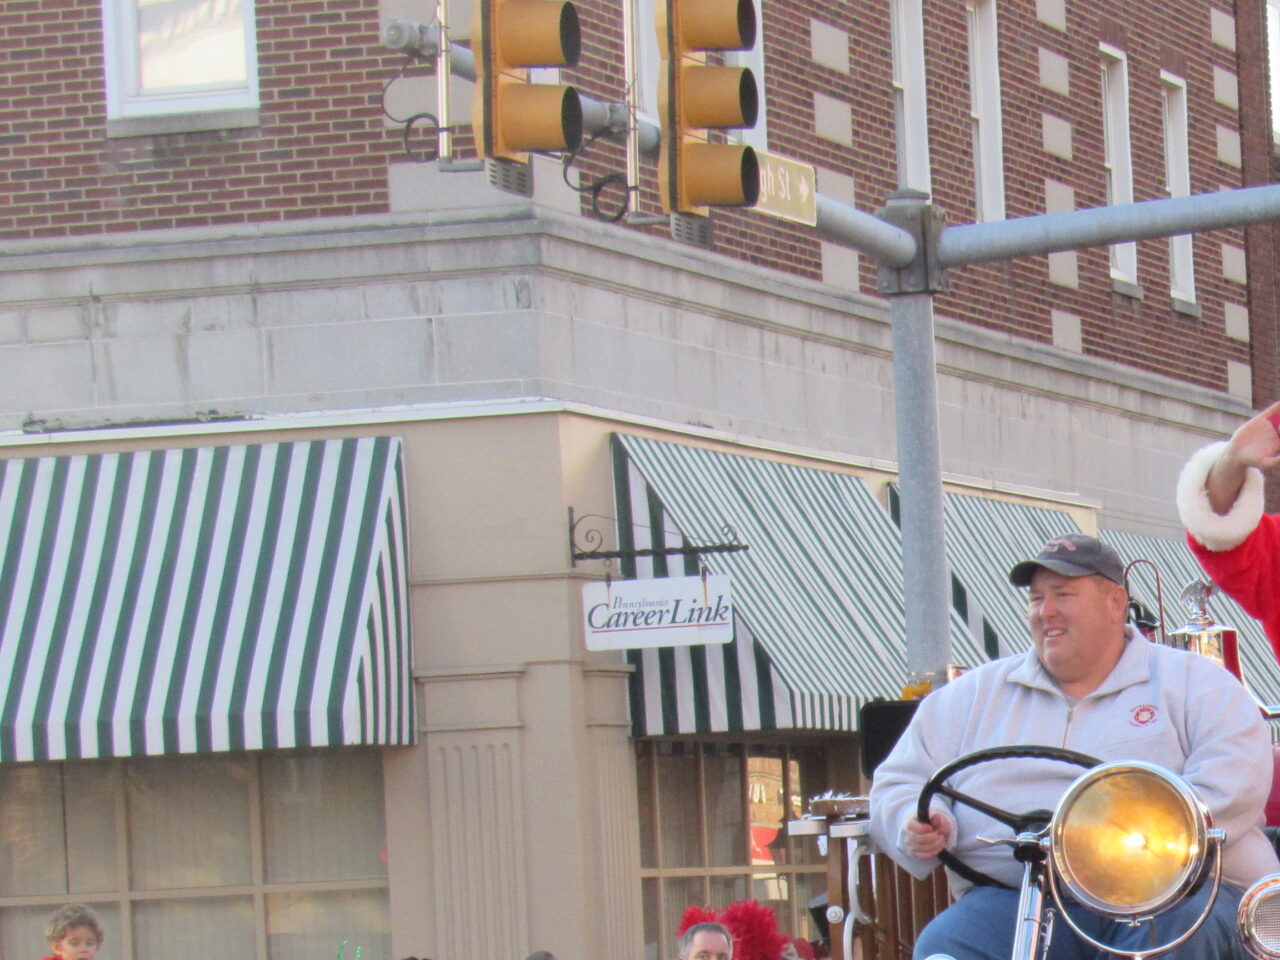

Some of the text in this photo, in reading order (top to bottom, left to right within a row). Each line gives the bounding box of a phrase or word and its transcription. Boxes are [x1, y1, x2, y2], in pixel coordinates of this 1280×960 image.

[760, 162, 791, 203] gh St
[587, 595, 730, 630] CareerLink
